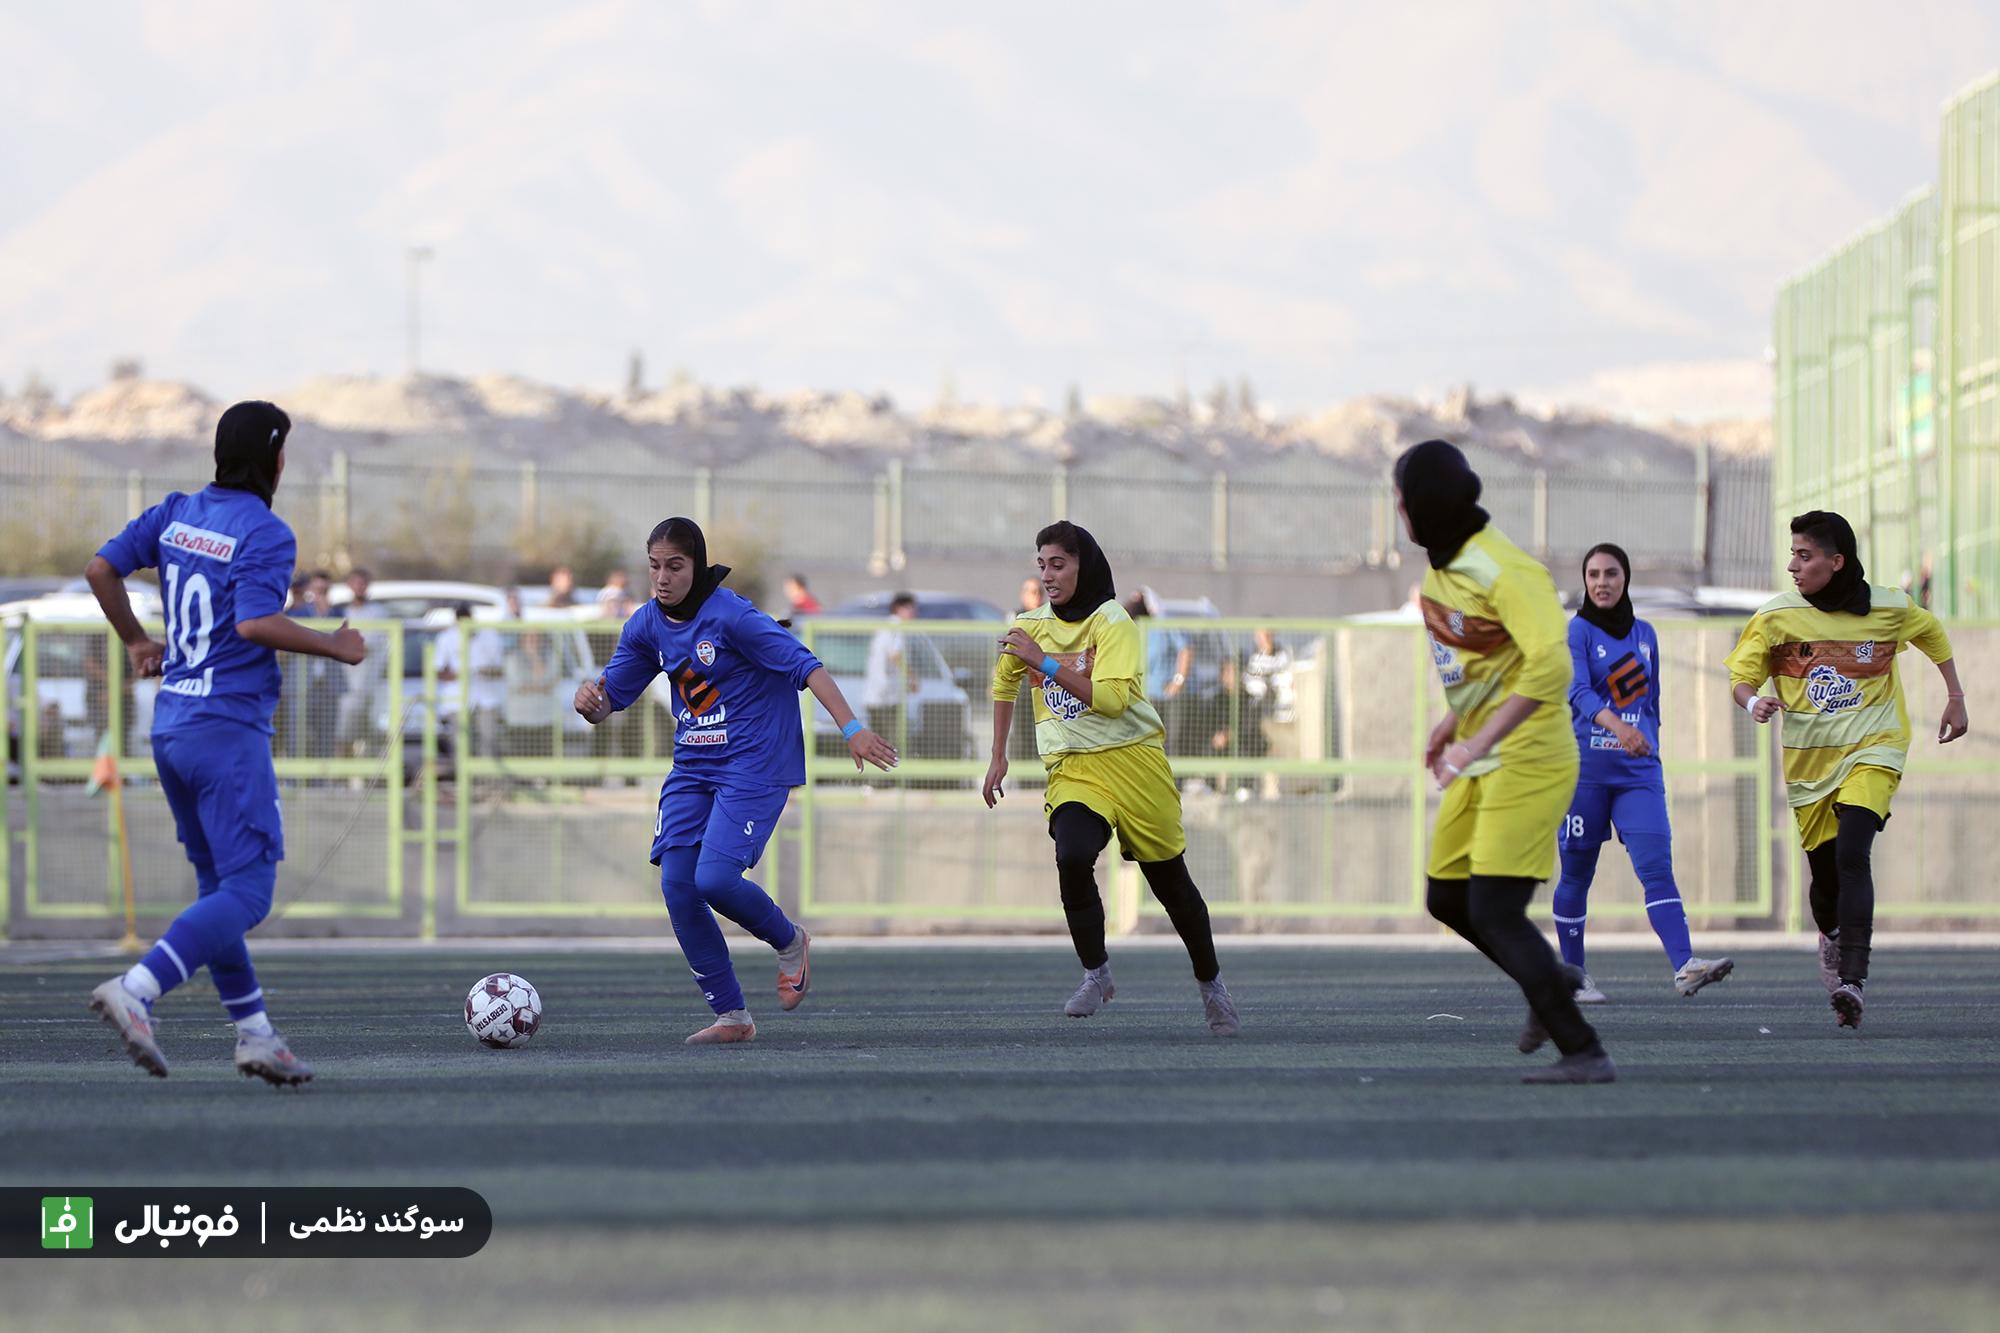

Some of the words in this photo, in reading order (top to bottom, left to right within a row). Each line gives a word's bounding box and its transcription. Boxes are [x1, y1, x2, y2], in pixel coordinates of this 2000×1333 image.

[165, 563, 214, 669] 10
[1811, 680, 1852, 701] Wash
[1820, 692, 1861, 713] Land
[1566, 814, 1584, 839] 18
